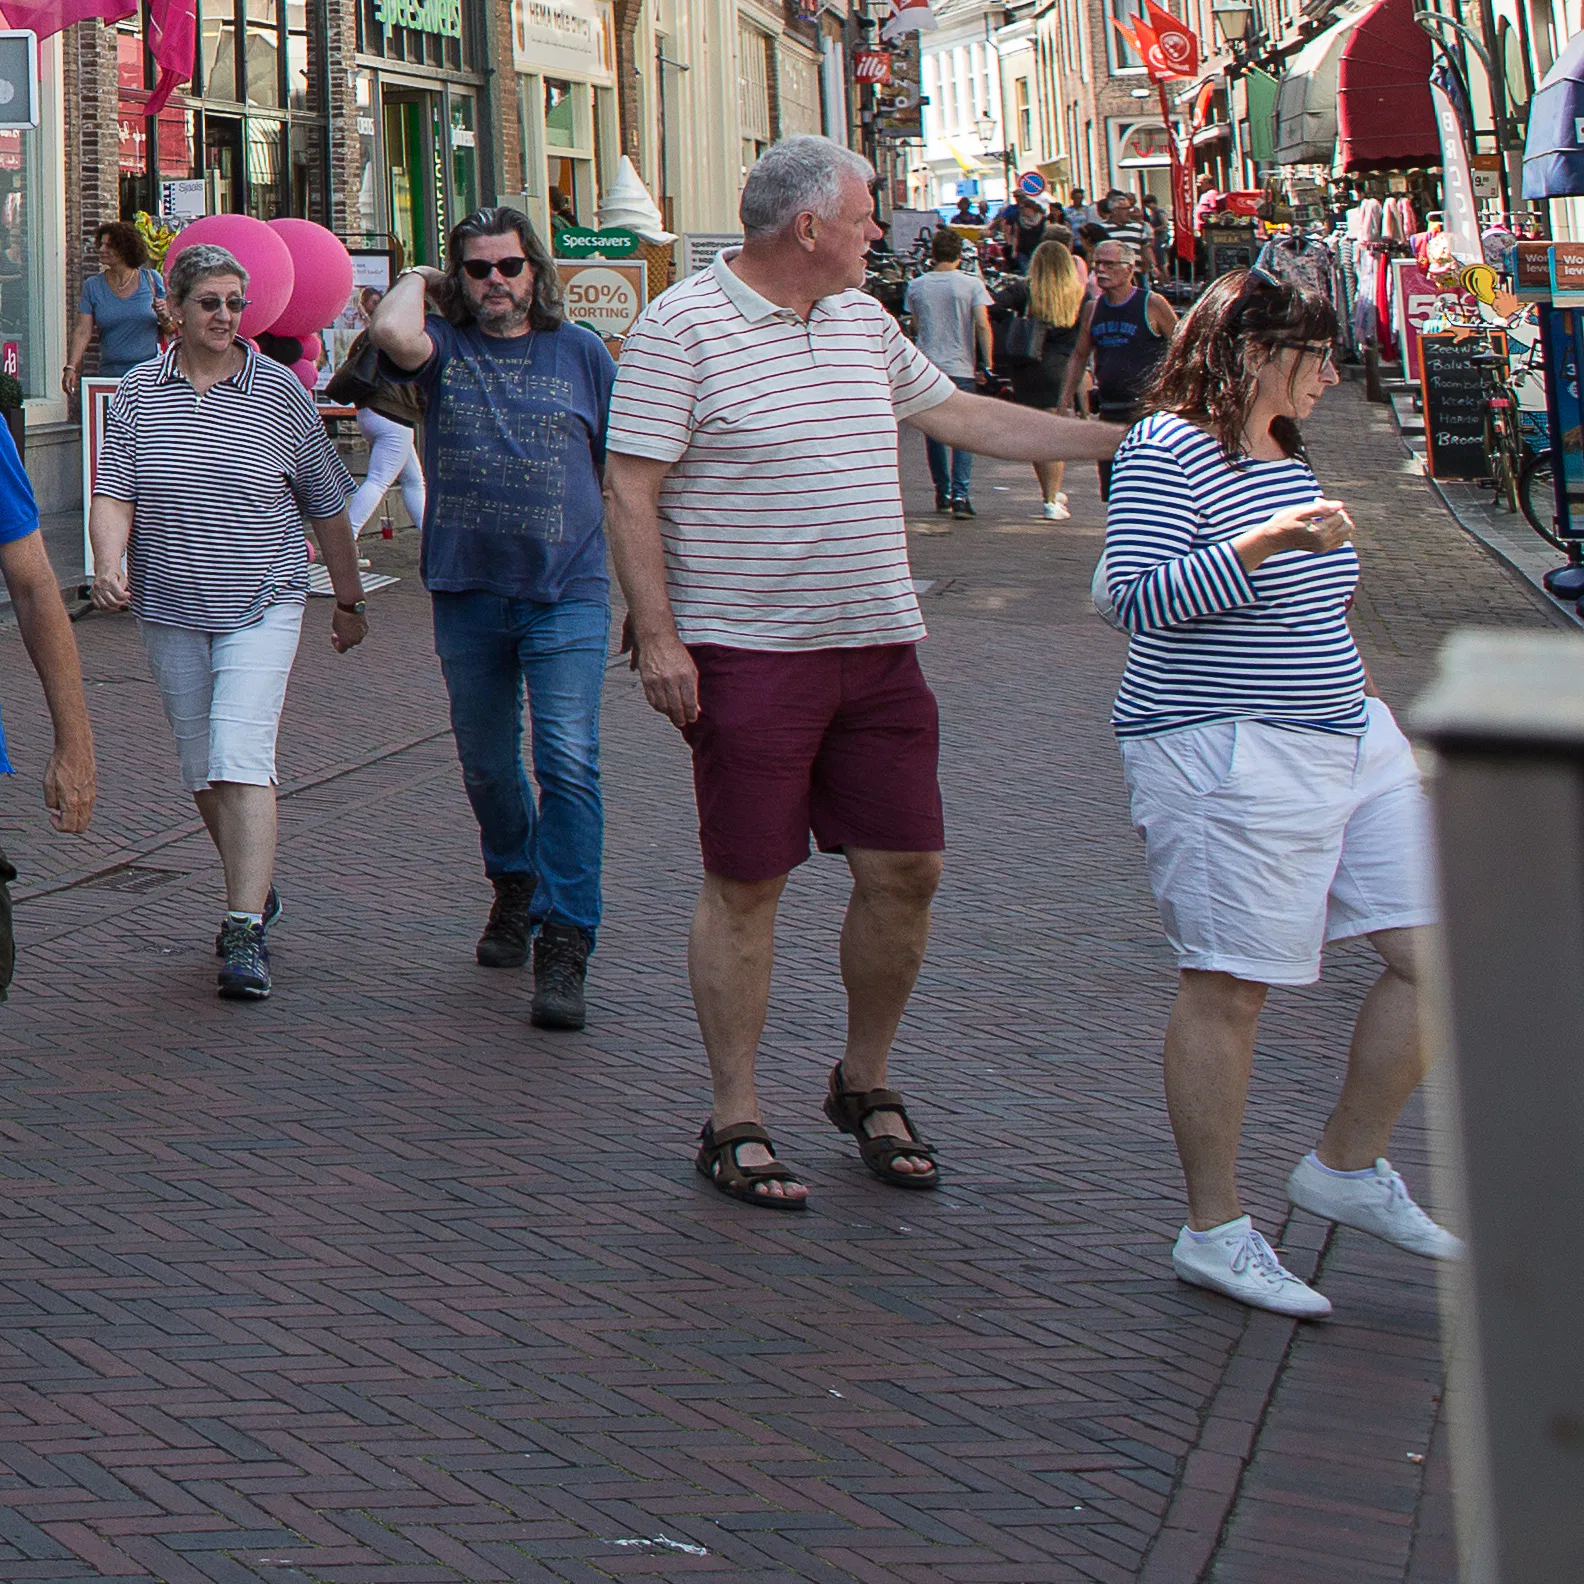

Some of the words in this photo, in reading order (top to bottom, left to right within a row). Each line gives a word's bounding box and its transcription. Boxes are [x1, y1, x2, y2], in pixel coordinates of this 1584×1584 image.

[857, 55, 888, 81] illy
[562, 234, 632, 248] Specsavers
[568, 284, 629, 305] 50%
[568, 306, 630, 320] KORTING
